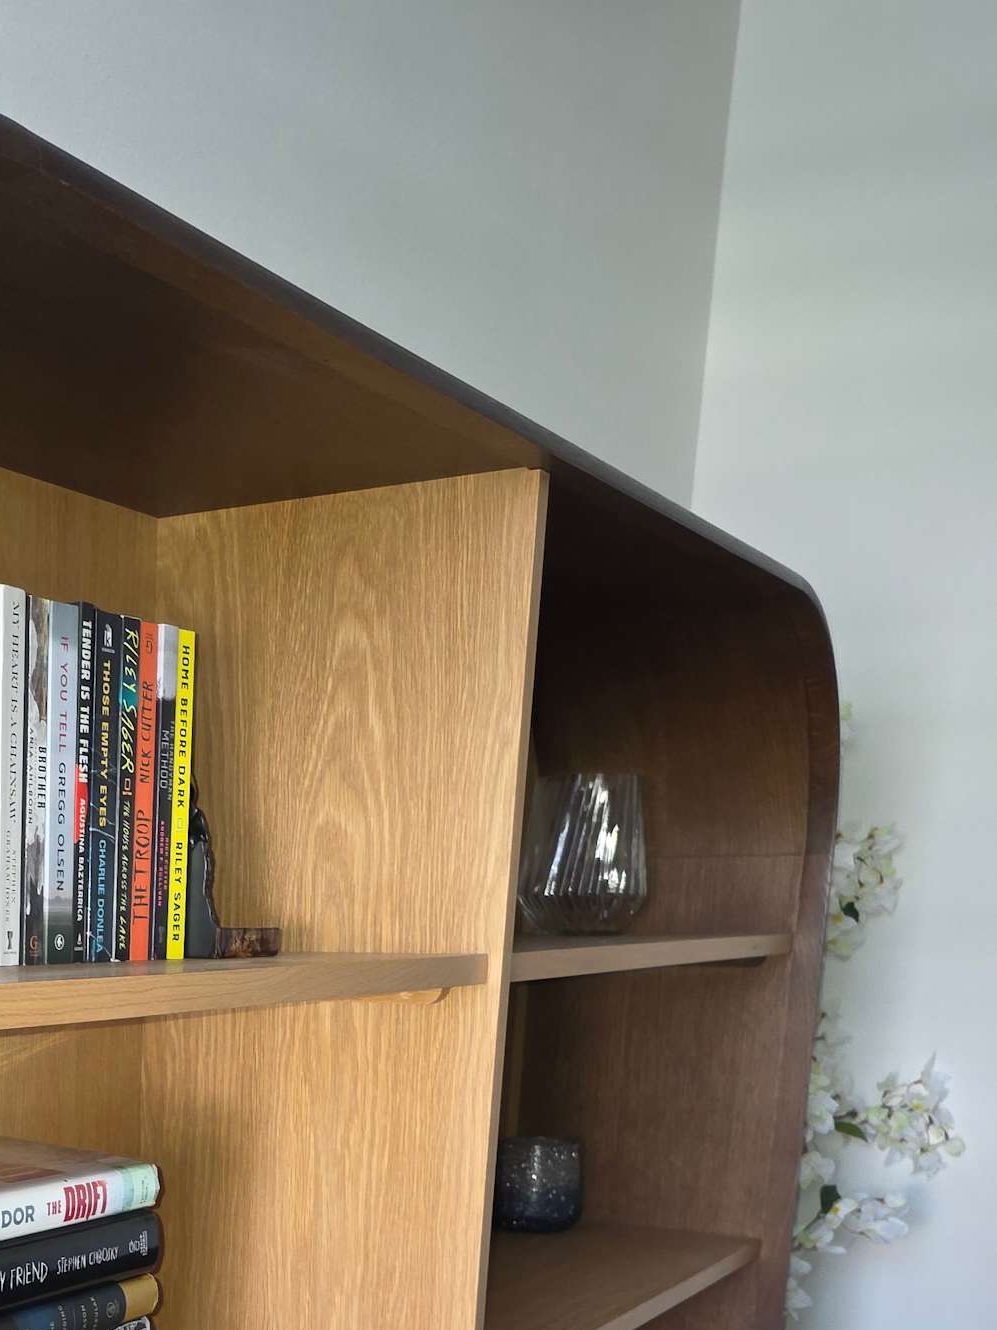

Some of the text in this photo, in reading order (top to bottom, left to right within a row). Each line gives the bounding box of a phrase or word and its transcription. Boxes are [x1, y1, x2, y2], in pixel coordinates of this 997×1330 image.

[123, 627, 139, 694] RILEY
[182, 645, 190, 690] HOME
[9, 601, 19, 823] MY HEART IS A CHAINSAW
[58, 636, 70, 753] IF YOU TELL
[79, 620, 92, 784] TENDER IS THE FLESH
[99, 659, 111, 827] THOSE EMPTY EYES
[121, 699, 137, 774] SAGER
[140, 681, 154, 784] NICK CUTTER
[179, 698, 188, 757] BEFORE
[37, 747, 46, 808] BROTHER
[160, 729, 169, 789] METHOD
[177, 768, 186, 808] DARK
[56, 762, 66, 891] GREGG OLSEN
[121, 821, 130, 851] HOUSE
[122, 801, 130, 819] THE
[76, 857, 84, 922] BAZTERRICA
[119, 851, 129, 893] ACROSS
[133, 809, 152, 925] THE TROOP
[173, 842, 183, 884] RILEY
[96, 840, 106, 953] CHARLIE DONLEA
[119, 894, 128, 913] THE
[172, 893, 181, 942] SAGER
[117, 916, 126, 950] LAKE
[46, 1200, 62, 1216] THE
[63, 1179, 108, 1222] DRIFT
[10, 1261, 49, 1291] FRIEND
[57, 1246, 120, 1275] STEPHEN CHBOSKY
